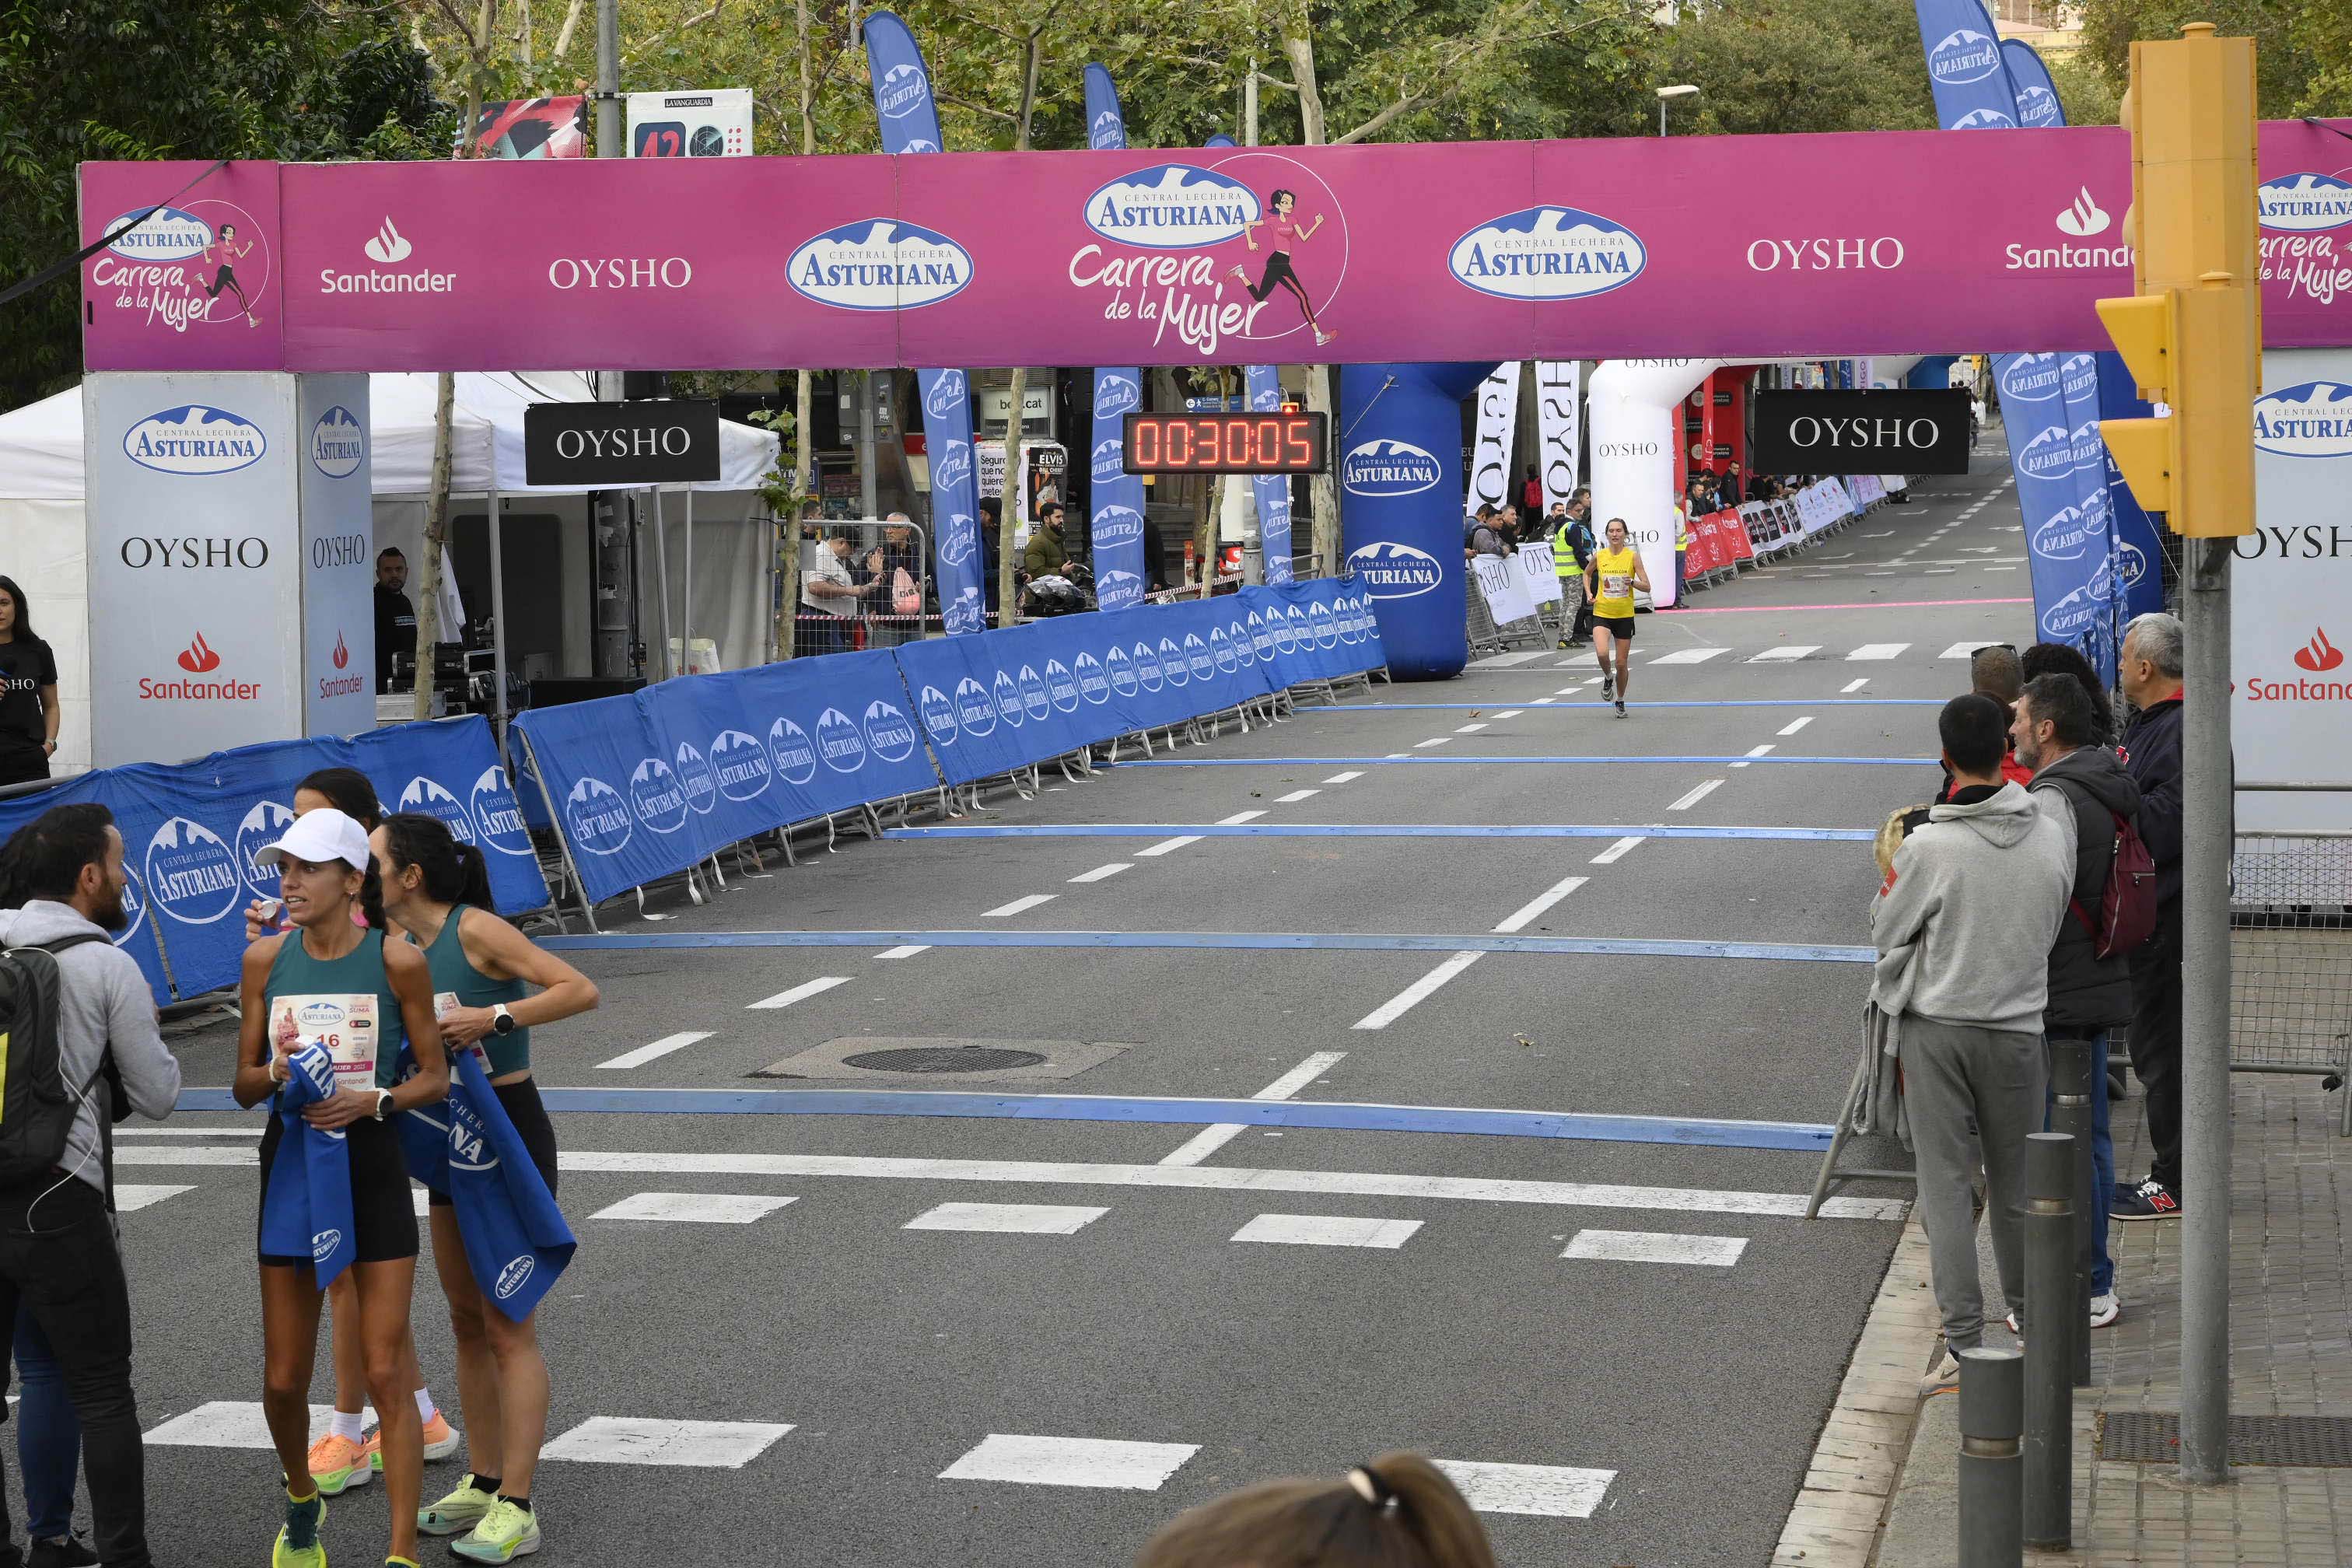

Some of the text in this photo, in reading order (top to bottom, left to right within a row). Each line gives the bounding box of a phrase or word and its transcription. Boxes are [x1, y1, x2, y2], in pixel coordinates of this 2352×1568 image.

[1125, 192, 1242, 202] CENTRAL LECHERA
[1097, 196, 1246, 227] ASTURIANA
[829, 248, 953, 260] CENTRAL LECHERA
[1494, 237, 1625, 249] CENTRAL LECHERA
[1747, 236, 1904, 271] OYSHO
[2259, 236, 2333, 258] arrera
[93, 257, 184, 287] Carrera
[548, 257, 692, 289] OYSHO
[800, 254, 959, 287] ASTURIANA
[1069, 244, 1214, 288] Carrera
[1464, 242, 1632, 277] ASTURIANA
[320, 268, 457, 293] Santander
[2277, 258, 2292, 280] la
[2287, 254, 2352, 305] Muje
[116, 284, 219, 332] de la Mujer
[1104, 282, 1269, 355] de la Mujer
[2275, 408, 2328, 417] CENTRAL
[134, 430, 257, 457] ASTURIANA
[156, 428, 251, 437] CENTRAL LECHERA
[555, 425, 691, 459] OYSHO
[1136, 421, 1311, 466] 00:30:05
[1789, 417, 1940, 449] OYSHO
[315, 436, 362, 460] ASTURIANA
[1039, 454, 1063, 465] ELVIS
[1599, 442, 1658, 457] OYSHO
[981, 467, 995, 476] que
[1346, 463, 1434, 485] ASTURIANA
[120, 537, 269, 569] OYSHO
[313, 534, 366, 569] OYSHO
[2232, 525, 2352, 559] OYSH
[1349, 565, 1435, 585] TURIANA
[138, 677, 261, 700] Santander
[320, 673, 364, 700] Santander
[821, 734, 863, 759] ASTURIANA
[485, 795, 511, 808] CENTRAL
[479, 802, 524, 836] ASTUR
[163, 847, 224, 868] CENTRAL LECHERA
[156, 861, 236, 902] ASTURIANA
[301, 1010, 341, 1020] ASTURIANA
[335, 1076, 368, 1086] Santander
[499, 1258, 534, 1297] ASTURIANA
